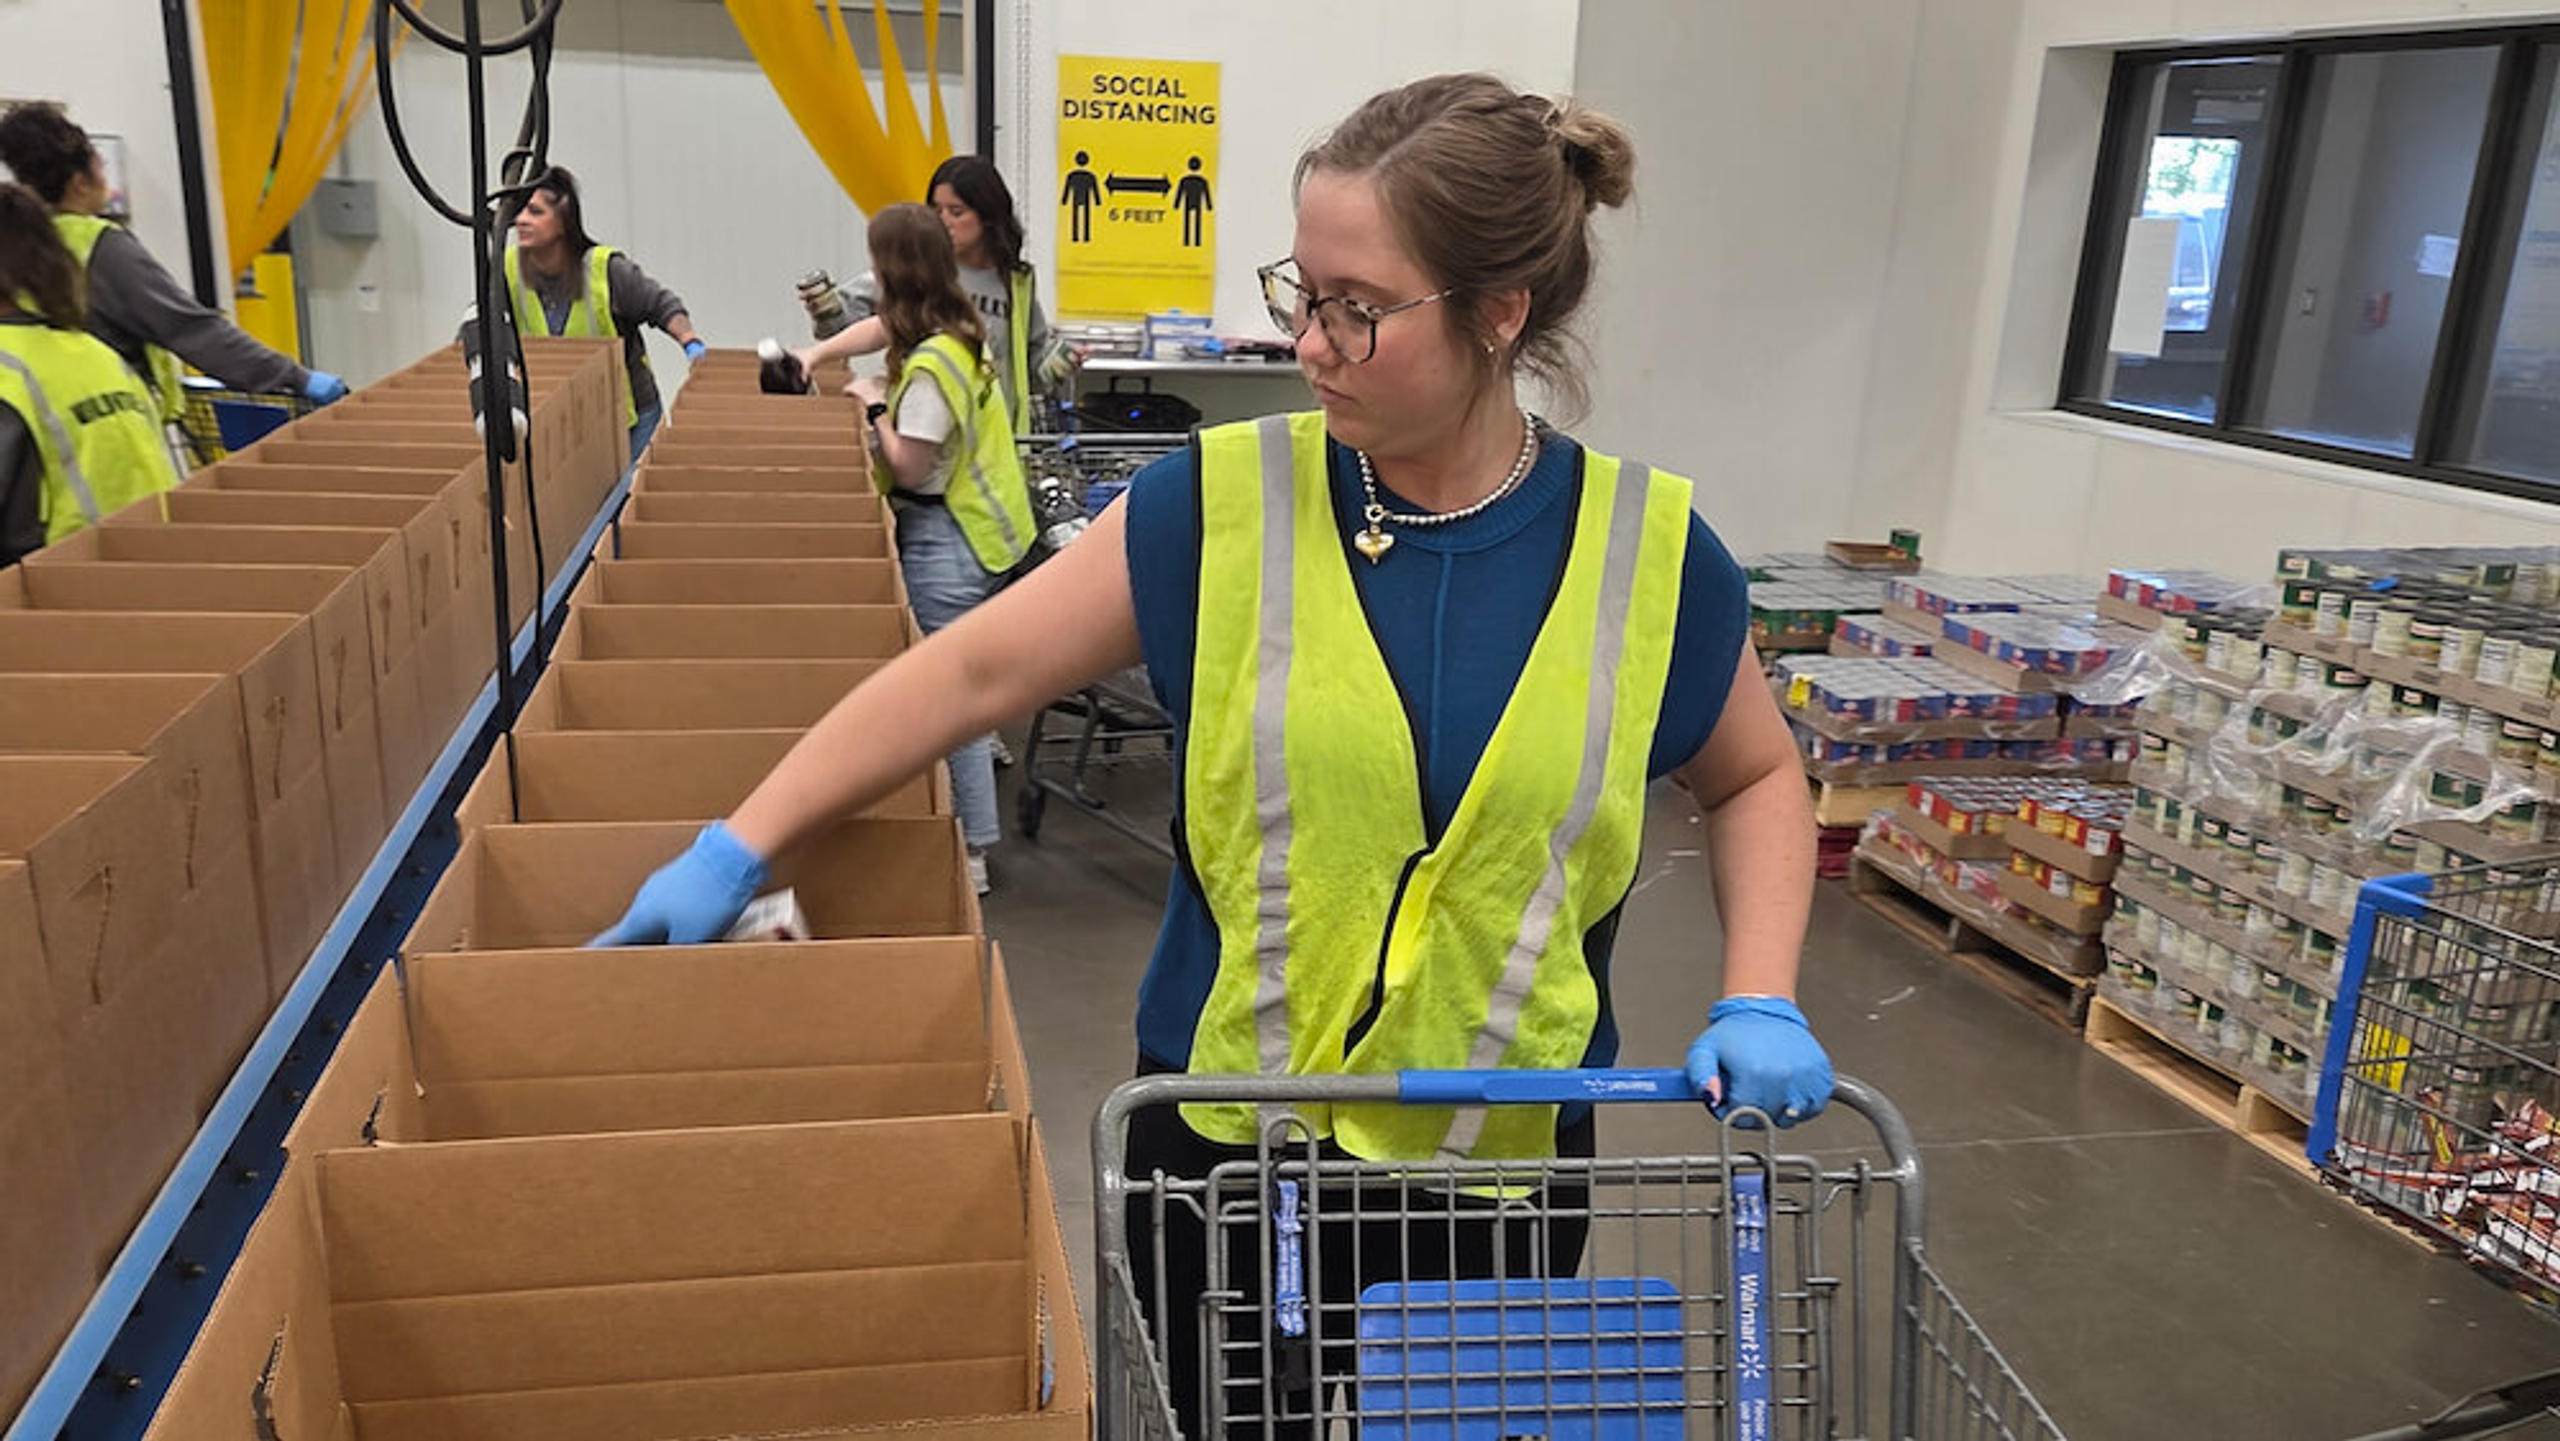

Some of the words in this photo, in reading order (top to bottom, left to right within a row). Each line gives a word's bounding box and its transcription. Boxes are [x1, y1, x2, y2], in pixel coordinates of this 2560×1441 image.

[1092, 75, 1187, 98] SOCIAL
[1063, 99, 1216, 124] DISTANCING
[1108, 208, 1119, 222] 6
[1124, 209, 1167, 223] FEET
[1740, 1273, 1761, 1351] Walmart
